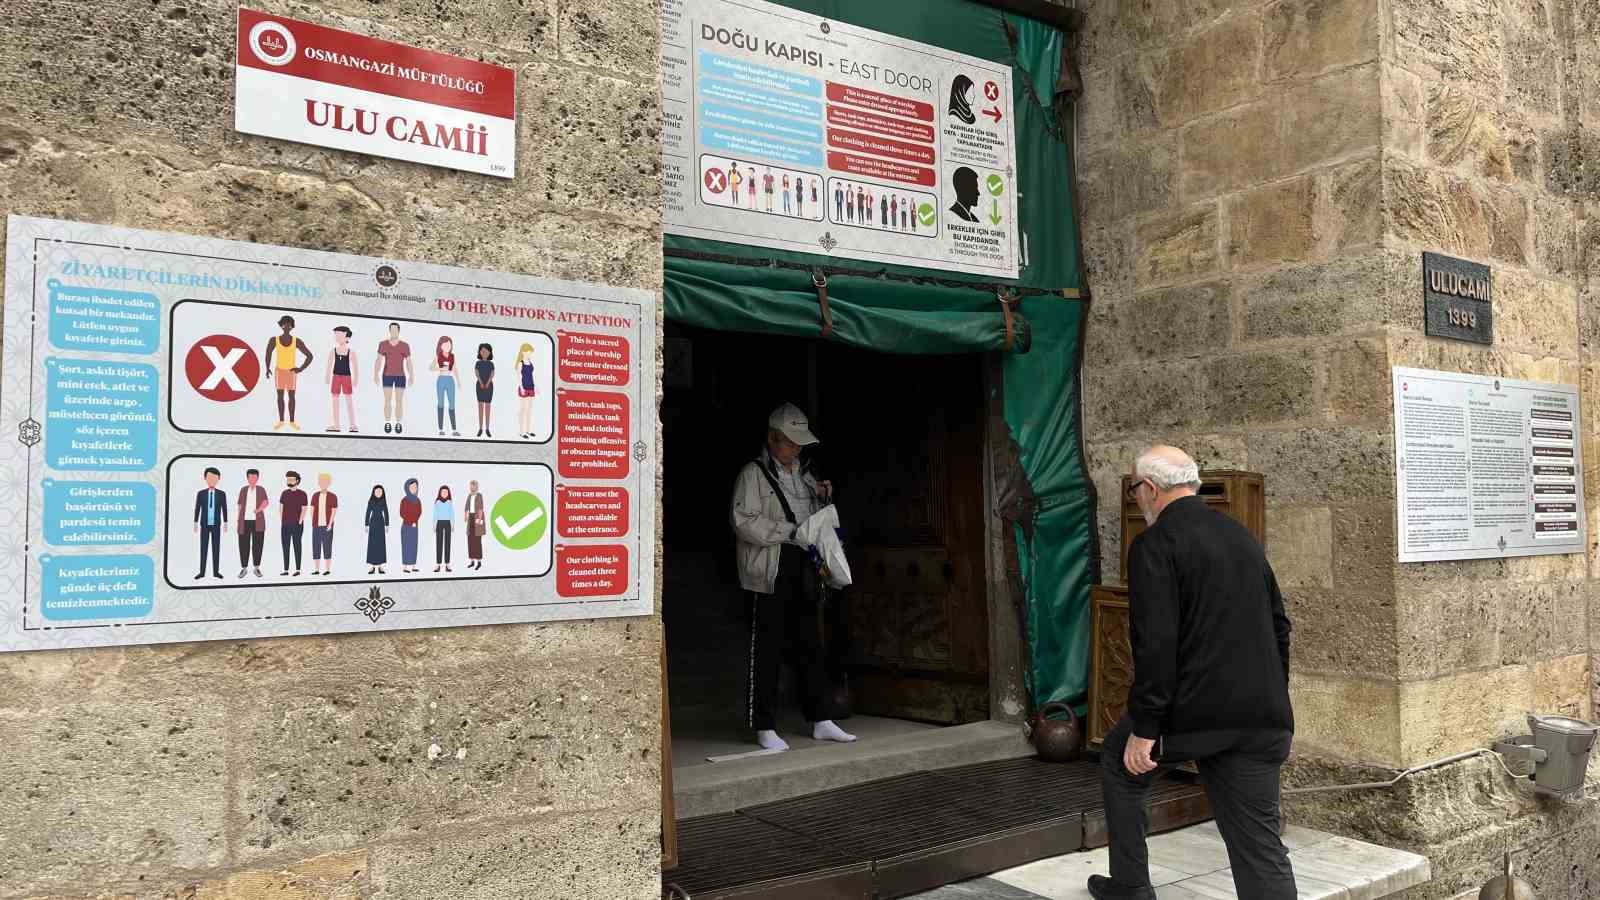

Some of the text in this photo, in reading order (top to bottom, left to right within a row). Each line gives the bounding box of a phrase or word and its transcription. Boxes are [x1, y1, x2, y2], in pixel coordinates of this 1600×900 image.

[702, 24, 758, 51] DOĞU
[765, 40, 822, 67] KAPISI
[840, 58, 880, 80] EAST
[885, 68, 932, 92] DOOR
[304, 46, 484, 94] OSMANGAZİ MÜFTÜLÜĞÜ
[304, 98, 379, 136] ULU
[225, 275, 322, 297] DİKKATİNE
[434, 300, 631, 328] TO THE VISITOR'S ATTENTION
[1448, 307, 1476, 327] 1399
[569, 336, 585, 344] This
[566, 348, 622, 360] place of worship
[561, 359, 583, 367] Please
[602, 361, 628, 370] dressed
[595, 424, 623, 434] clothing
[560, 436, 597, 445] containing
[598, 448, 626, 458] language
[581, 555, 611, 564] clothing
